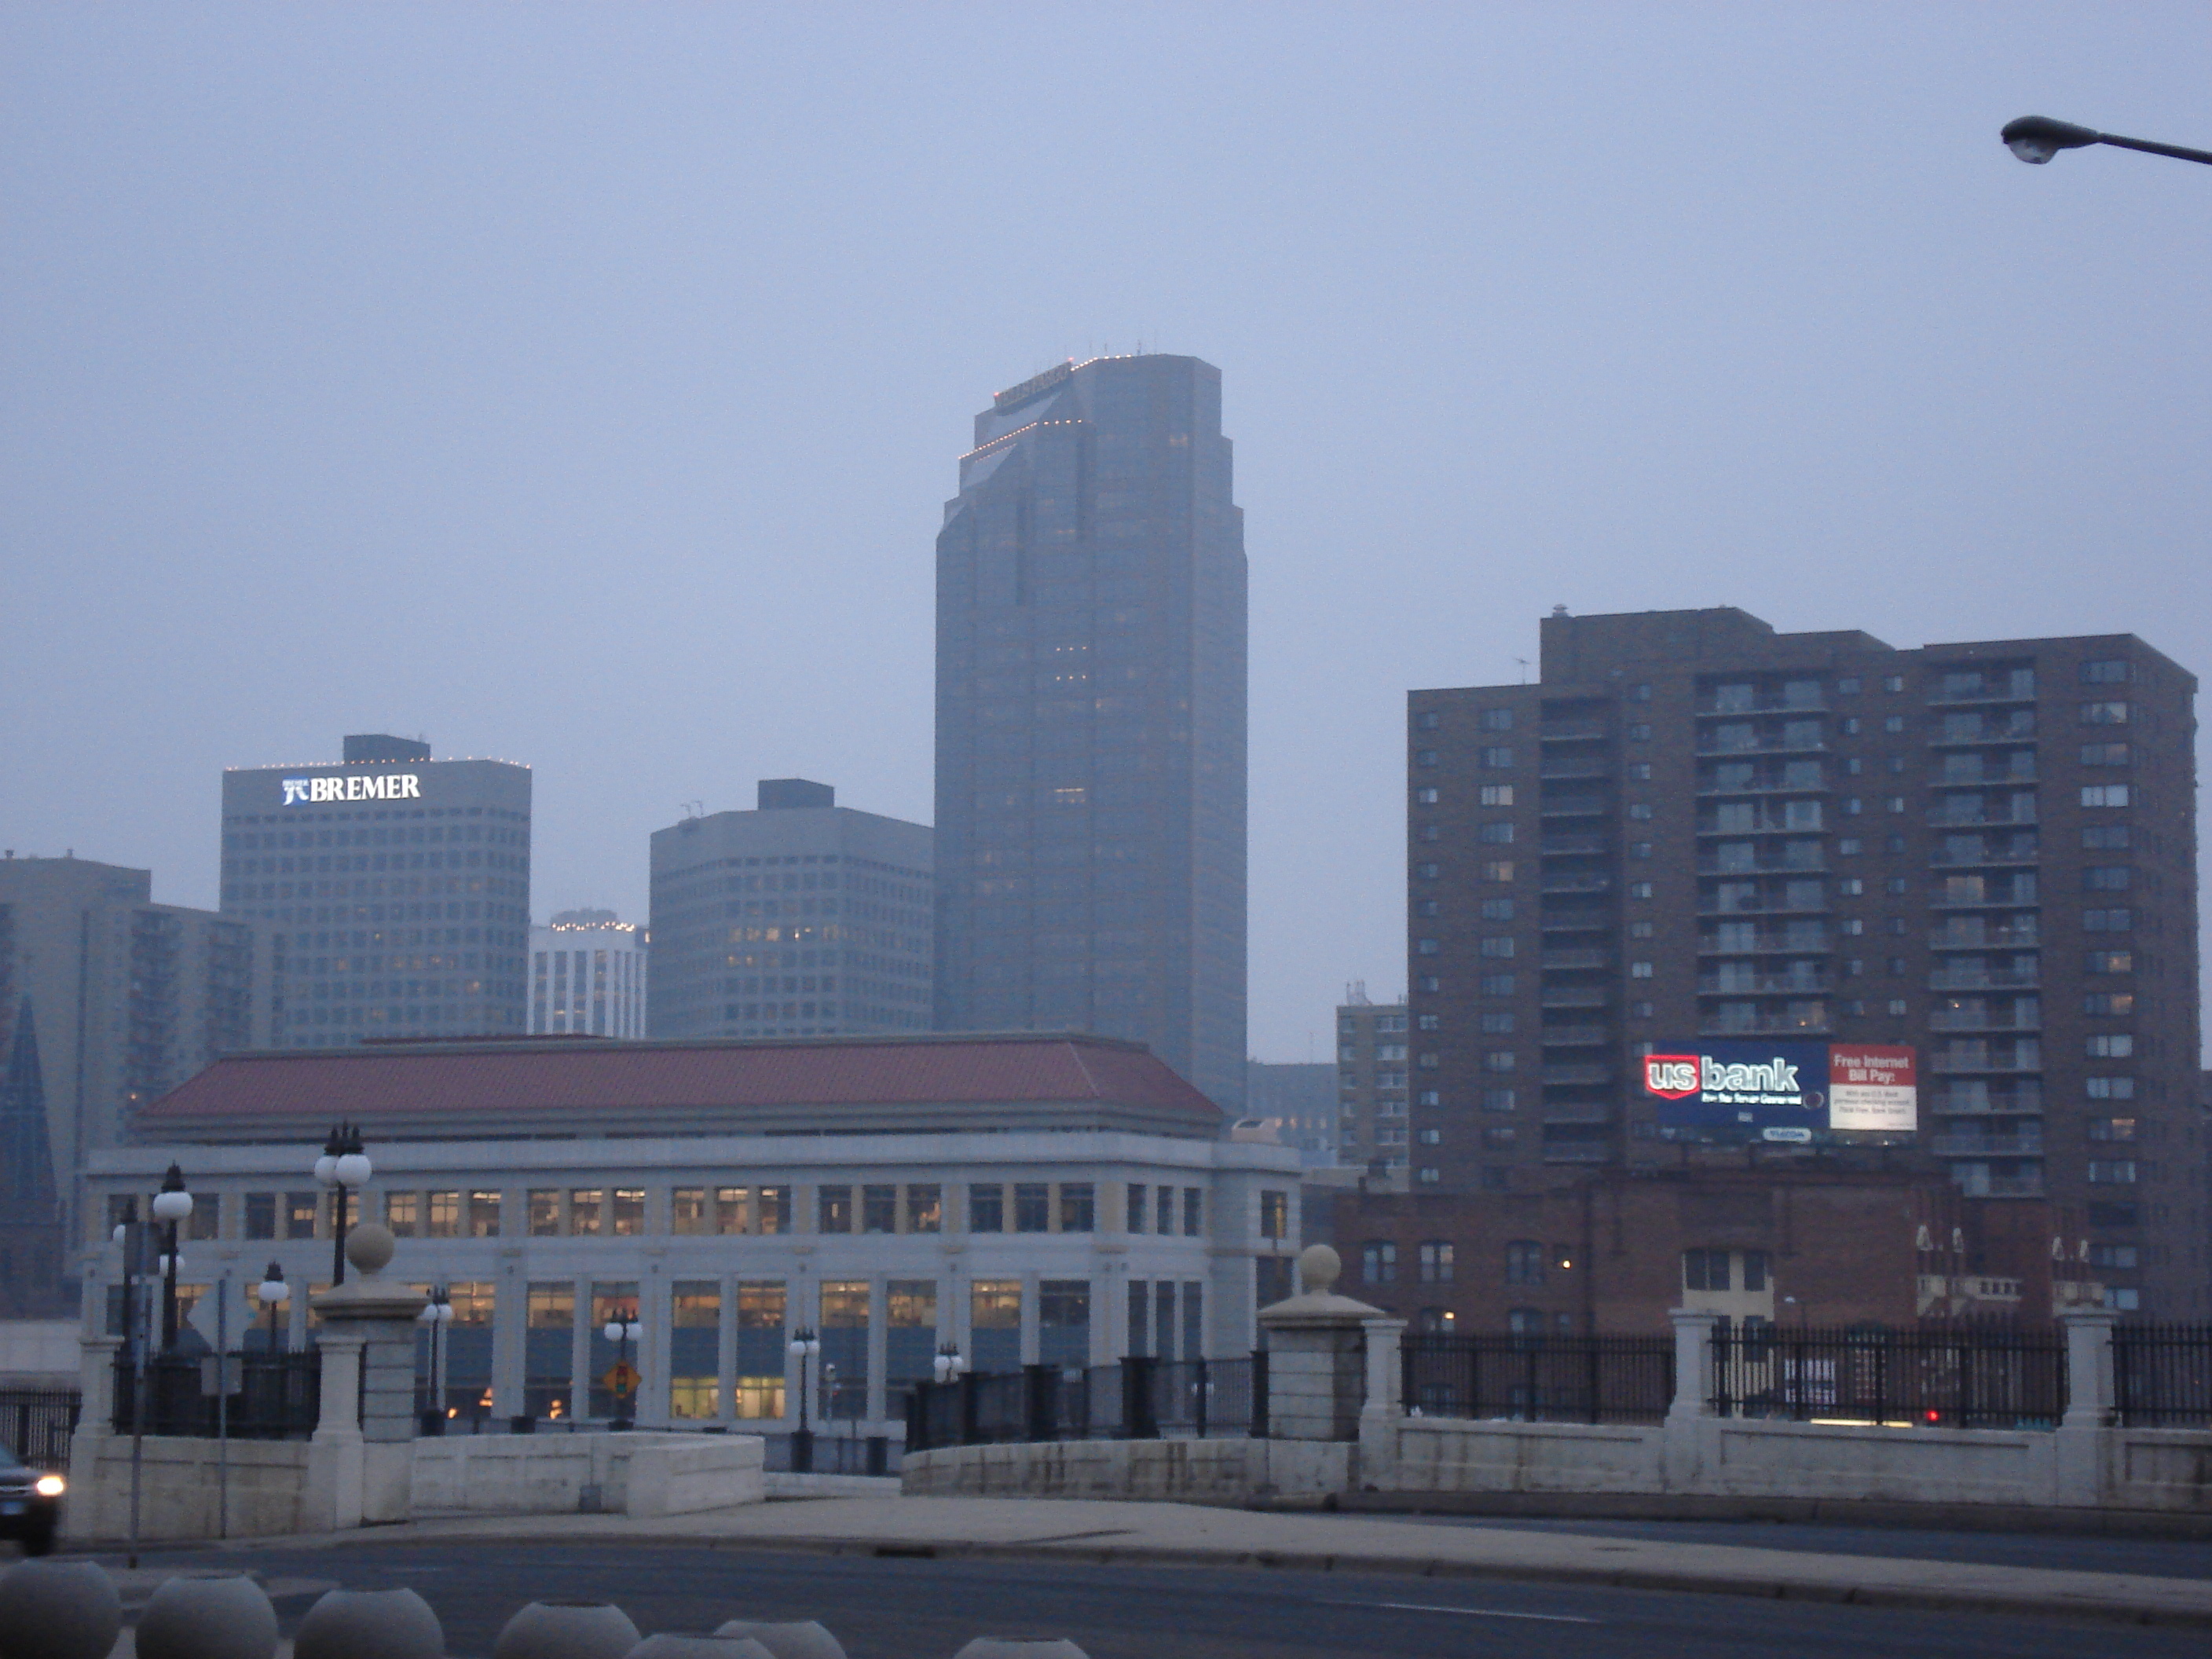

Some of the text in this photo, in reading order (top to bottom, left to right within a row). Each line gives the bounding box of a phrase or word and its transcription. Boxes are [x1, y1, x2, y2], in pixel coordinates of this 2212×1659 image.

[310, 774, 421, 802] BREMER
[1833, 1053, 1909, 1069] Free Internet
[1701, 1055, 1800, 1092] bank
[1848, 1068, 1867, 1082] Bill
